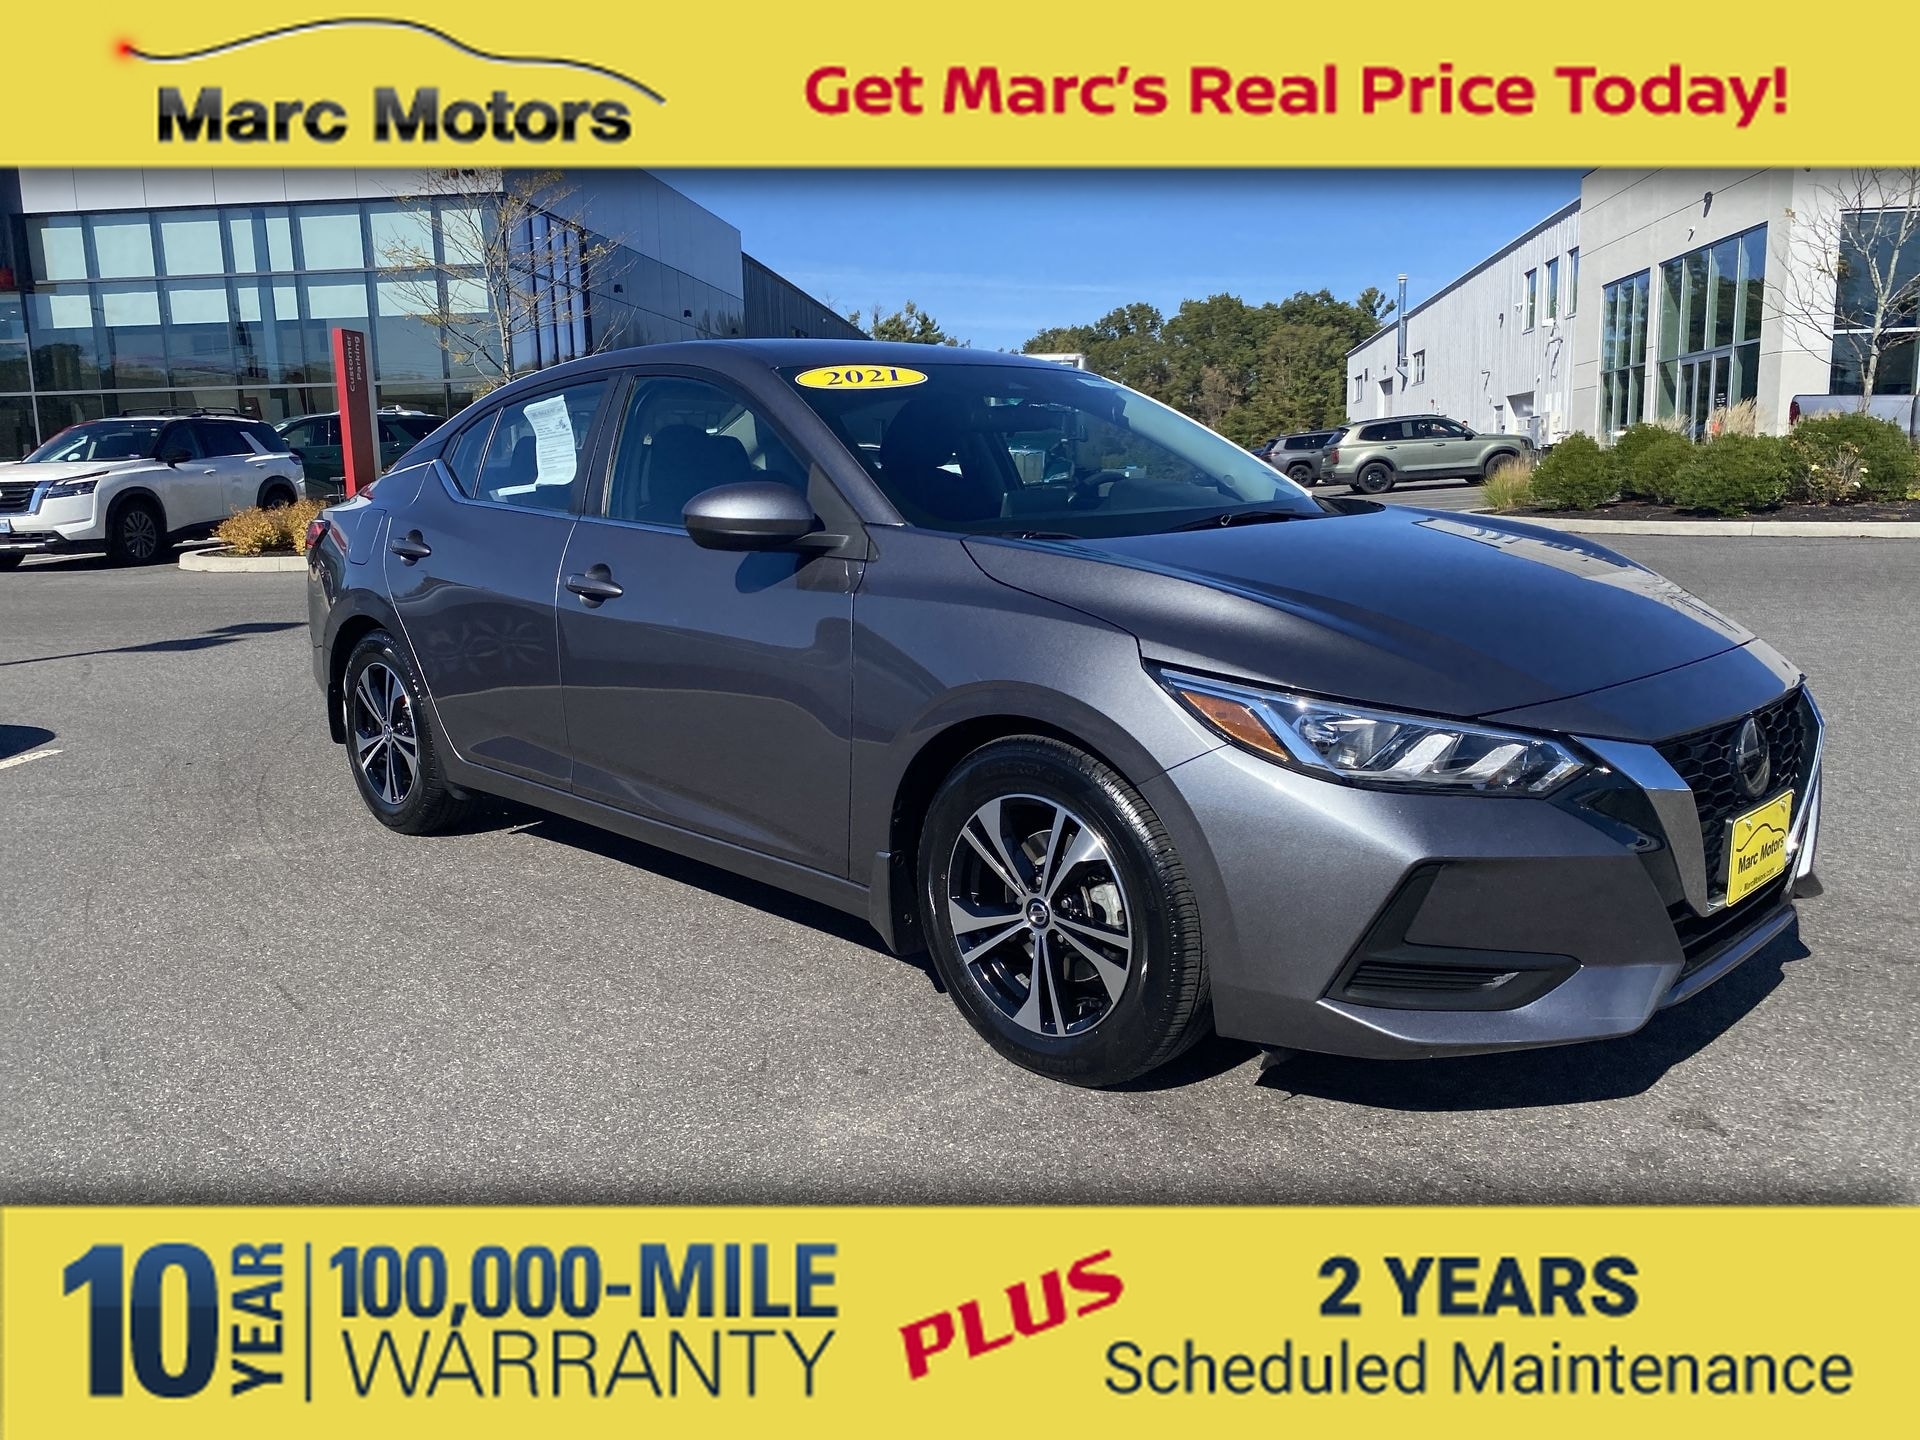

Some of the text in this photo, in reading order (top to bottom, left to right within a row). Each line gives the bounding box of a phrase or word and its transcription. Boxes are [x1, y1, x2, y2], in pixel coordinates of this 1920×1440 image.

[347, 335, 355, 392] Customer
[824, 368, 901, 386] 2021
[1737, 836, 1784, 875] Marc Motors
